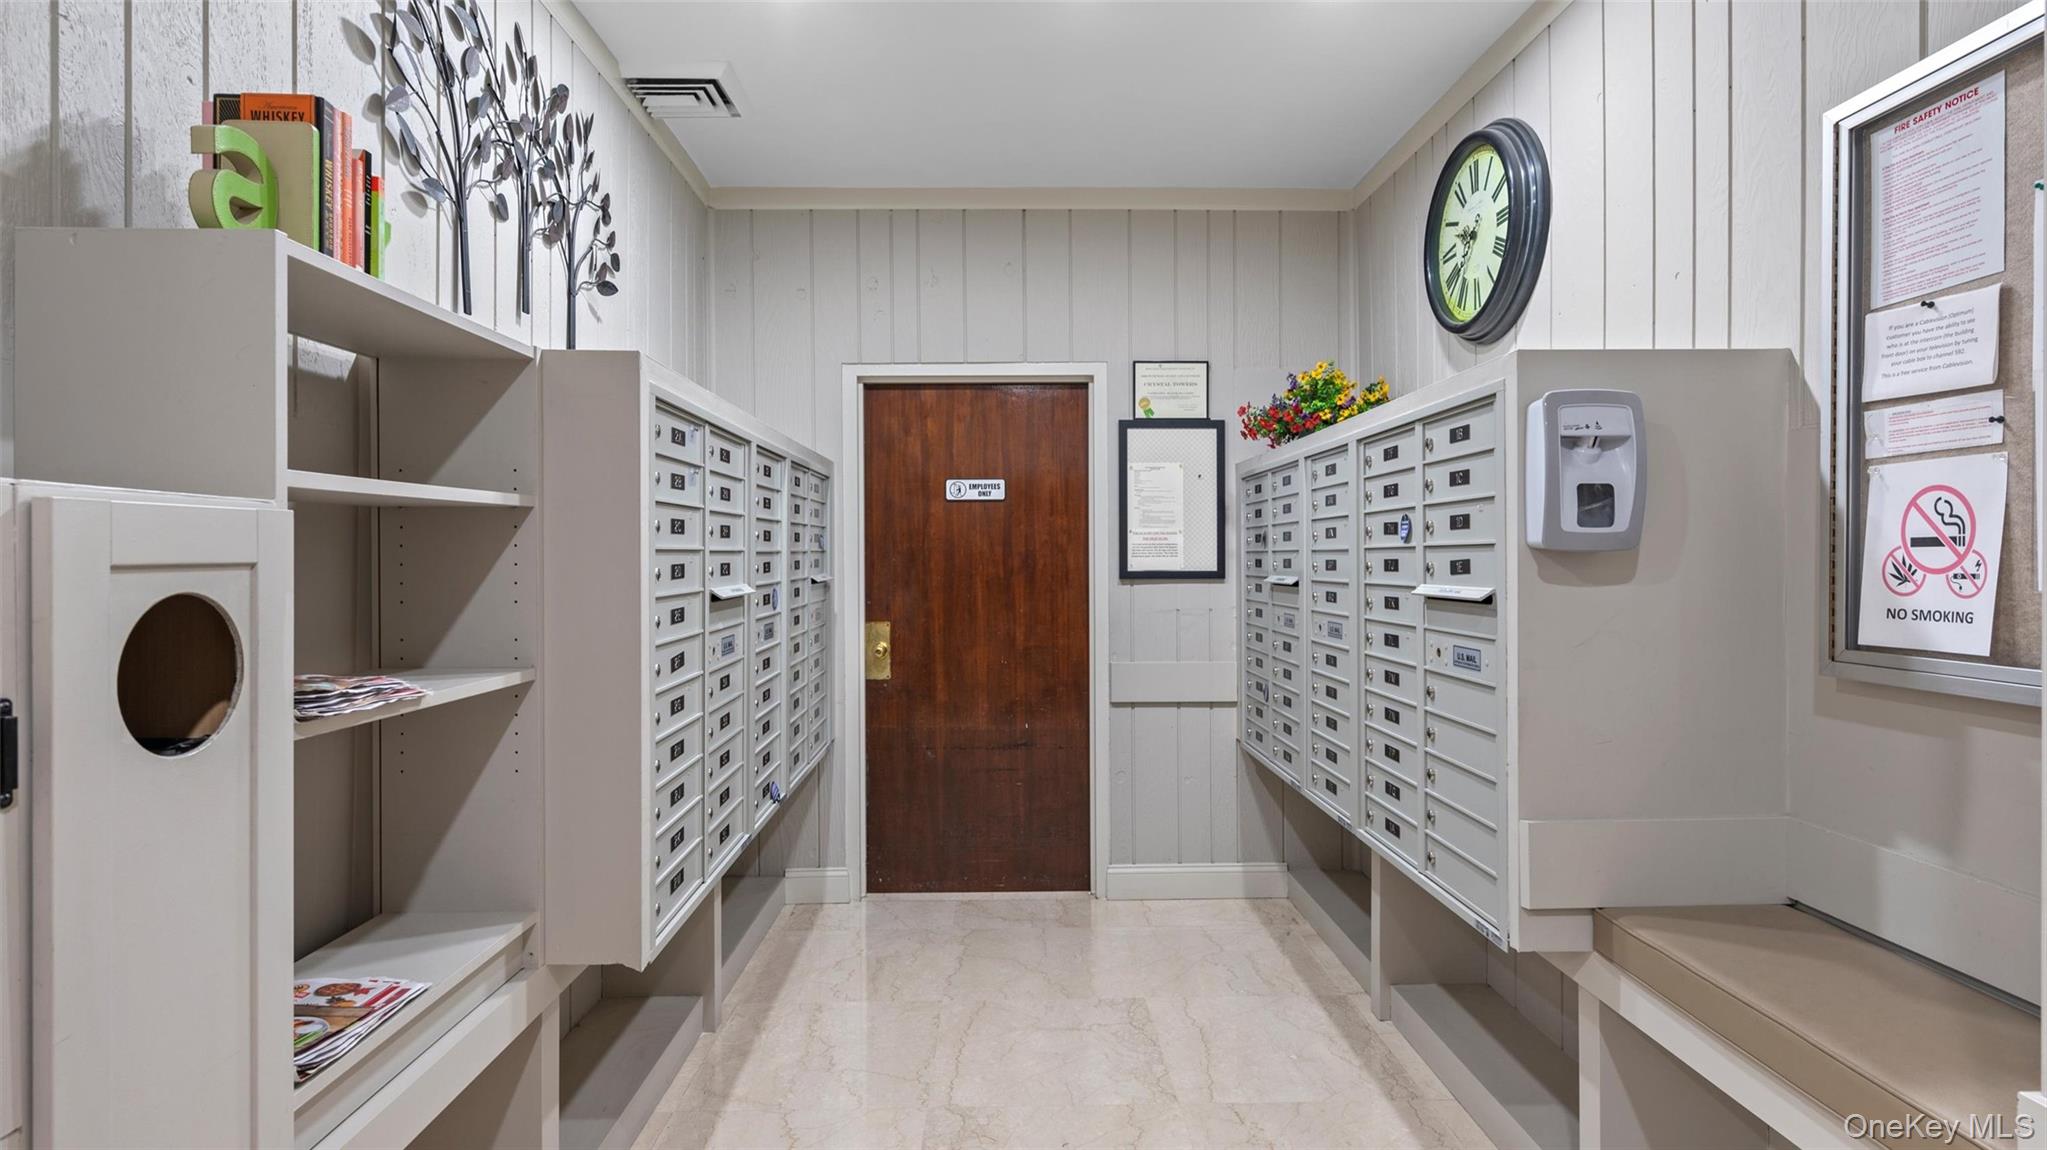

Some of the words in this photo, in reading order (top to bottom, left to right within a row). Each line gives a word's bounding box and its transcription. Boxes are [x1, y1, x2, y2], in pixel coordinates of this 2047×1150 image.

[250, 110, 305, 122] WHISKEY
[1894, 121, 1910, 134] FIRE
[1912, 105, 1942, 126] SAFETY
[1944, 87, 1980, 110] NOTICE
[324, 159, 334, 210] WHISKEY
[1886, 332, 1911, 340] customer
[1955, 328, 1974, 336] building
[1929, 342, 1953, 351] television
[1933, 351, 1953, 359] channel
[1886, 608, 1908, 620] NO
[1911, 609, 1974, 624] SMOKING
[1456, 653, 1465, 661] U.S.
[1466, 655, 1477, 664] MAIL
